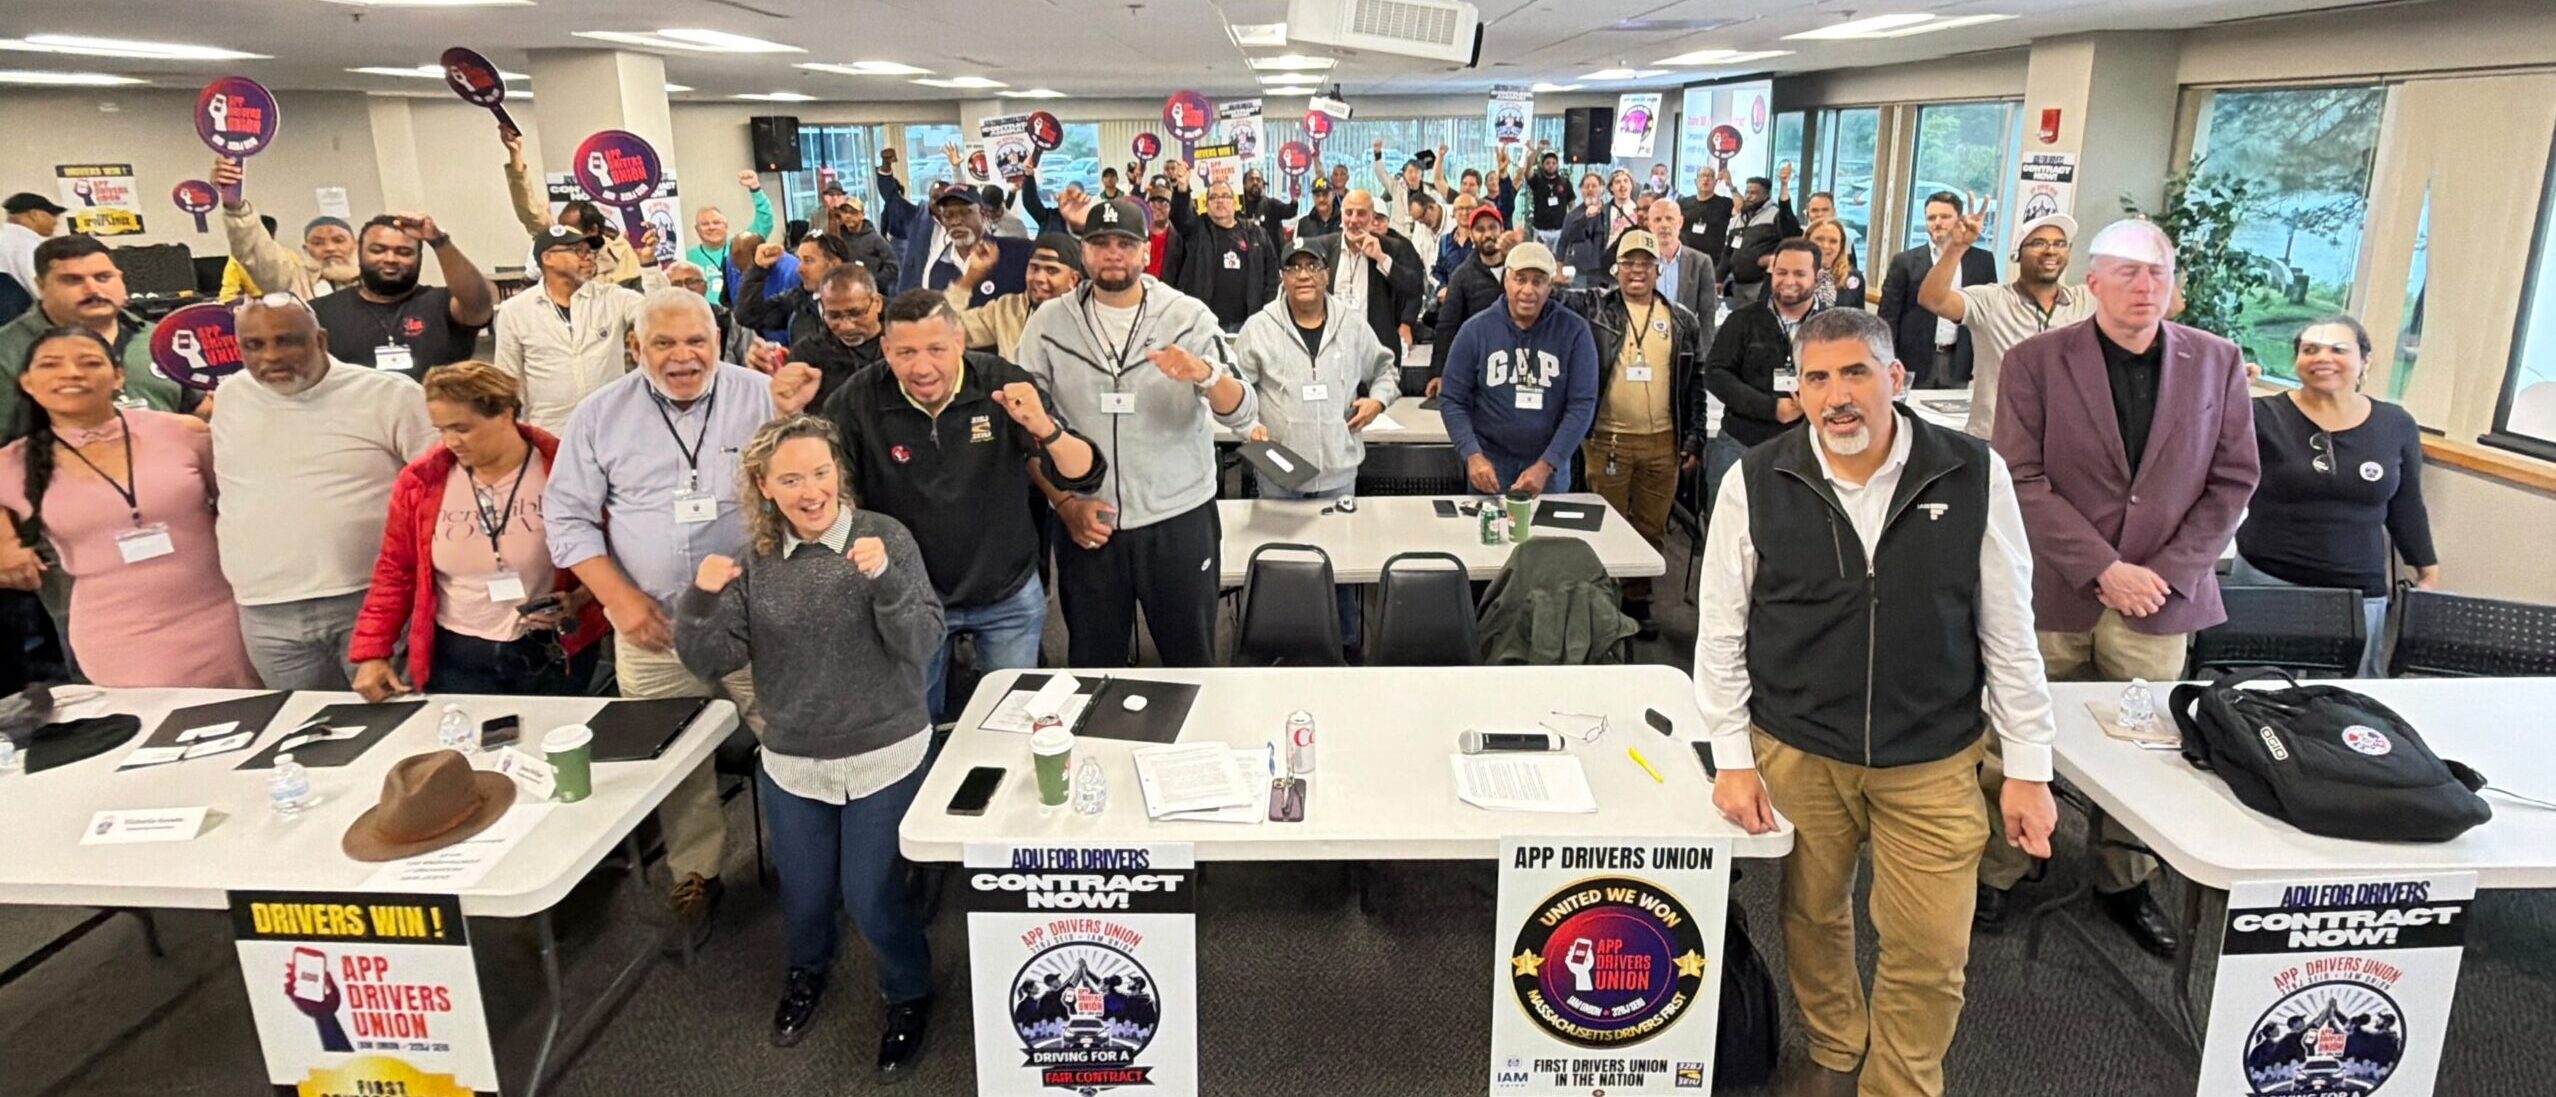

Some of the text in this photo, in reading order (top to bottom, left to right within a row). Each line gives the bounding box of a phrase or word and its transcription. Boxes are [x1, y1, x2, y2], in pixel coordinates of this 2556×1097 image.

[1103, 203, 1118, 223] LA
[1486, 348, 1560, 388] GAP
[2261, 728, 2287, 758] OGIO
[1012, 848, 1150, 870] ADU FOR DRIVERS
[1514, 846, 1714, 870] APP DRIVERS UNION
[971, 873, 1184, 892] CONTRACT
[1027, 891, 1130, 909] NOW!
[2281, 881, 2431, 908] ADU FOR DRIVERS
[1540, 887, 1682, 929] UNITED WE WON
[2232, 906, 2462, 932] CONTRACT
[251, 902, 445, 938] DRIVERS WIN !
[1021, 919, 1143, 949] APP DRIVERS UNION
[2288, 927, 2399, 949] NOW!
[1597, 939, 1623, 954] APP
[341, 955, 389, 982] APP
[1596, 954, 1652, 970] DRIVERS
[2273, 957, 2403, 989] APP DRIVERS UNION
[1595, 970, 1650, 990] UNION
[345, 984, 452, 1012] DRIVERS
[352, 1013, 428, 1039] UNION
[1527, 989, 1687, 1041] MASSACHUSETTS DRIVERS FIRST
[1033, 1051, 1130, 1063] DRIVING FOR A
[1534, 1059, 1668, 1073] FIRST DRIVERS UNION
[357, 1080, 406, 1095] FIRST
[1045, 1071, 1144, 1084] FAIR CONTRACT
[1497, 1071, 1528, 1083] IAM
[1555, 1073, 1644, 1087] IN THE NATION
